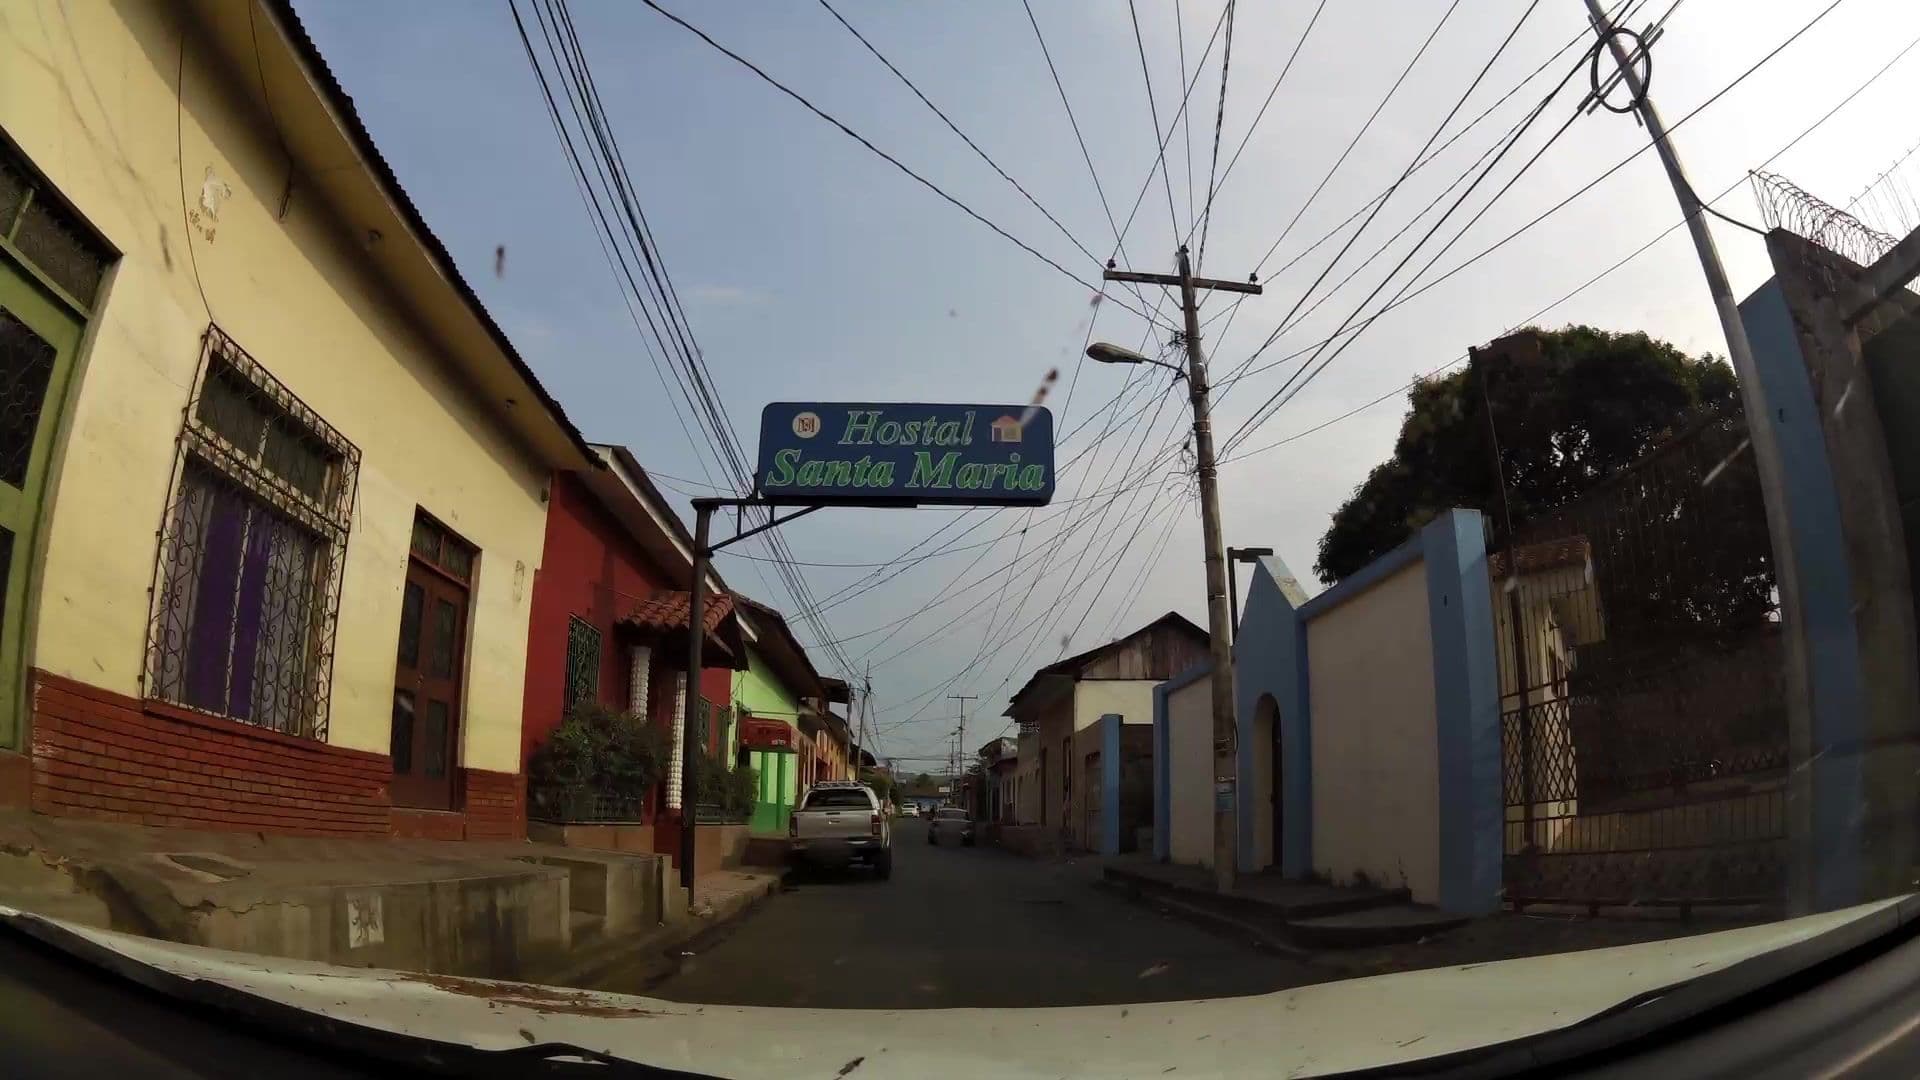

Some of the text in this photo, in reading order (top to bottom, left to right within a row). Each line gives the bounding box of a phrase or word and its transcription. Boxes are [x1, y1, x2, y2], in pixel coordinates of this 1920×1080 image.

[838, 410, 976, 446] Hostal
[766, 449, 1045, 491] Santa Maria
